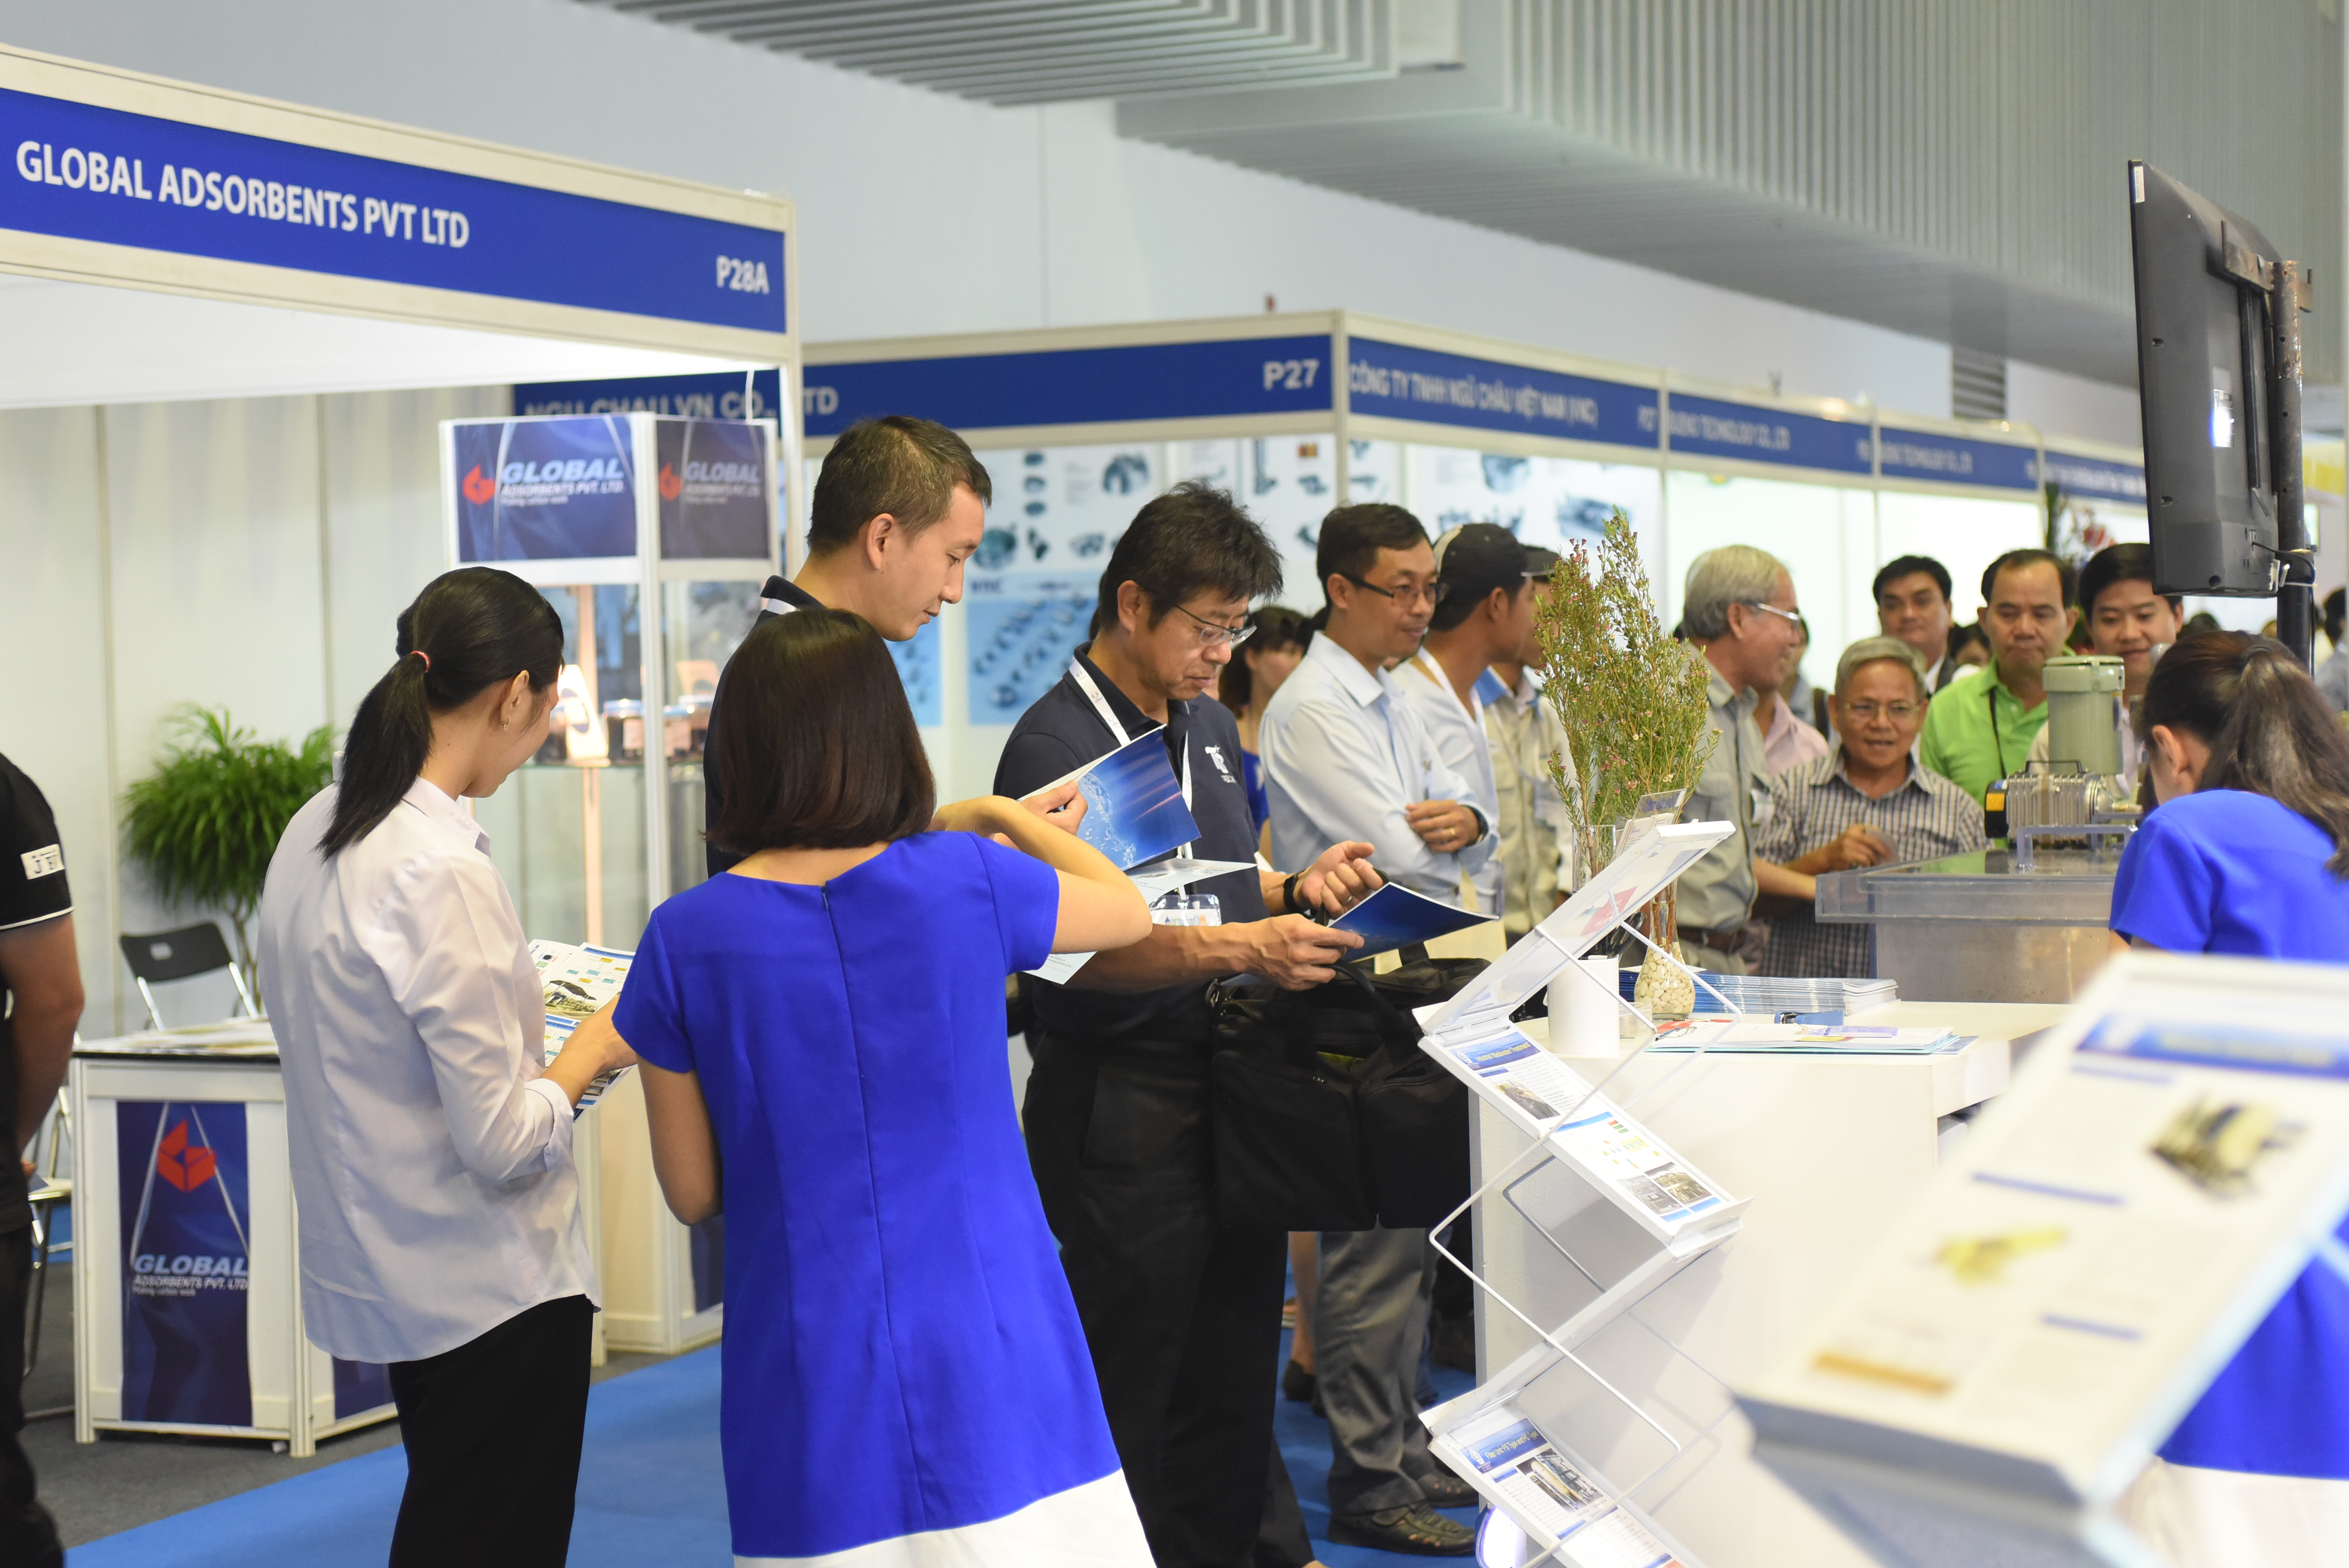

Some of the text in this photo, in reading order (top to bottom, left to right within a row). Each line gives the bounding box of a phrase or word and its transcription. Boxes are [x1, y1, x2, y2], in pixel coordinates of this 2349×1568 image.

[16, 141, 470, 248] GLOBAL ADSORBENTS PVT LTD
[716, 256, 770, 294] P28A
[1264, 358, 1319, 390] P27
[502, 458, 624, 484] GLOBAL
[686, 461, 759, 483] GLOBAL
[135, 1254, 248, 1276] GLOBAL
[134, 1275, 202, 1288] ADSORBENTS
[1507, 1441, 1518, 1450] Type
[1527, 1431, 1539, 1440] Type
